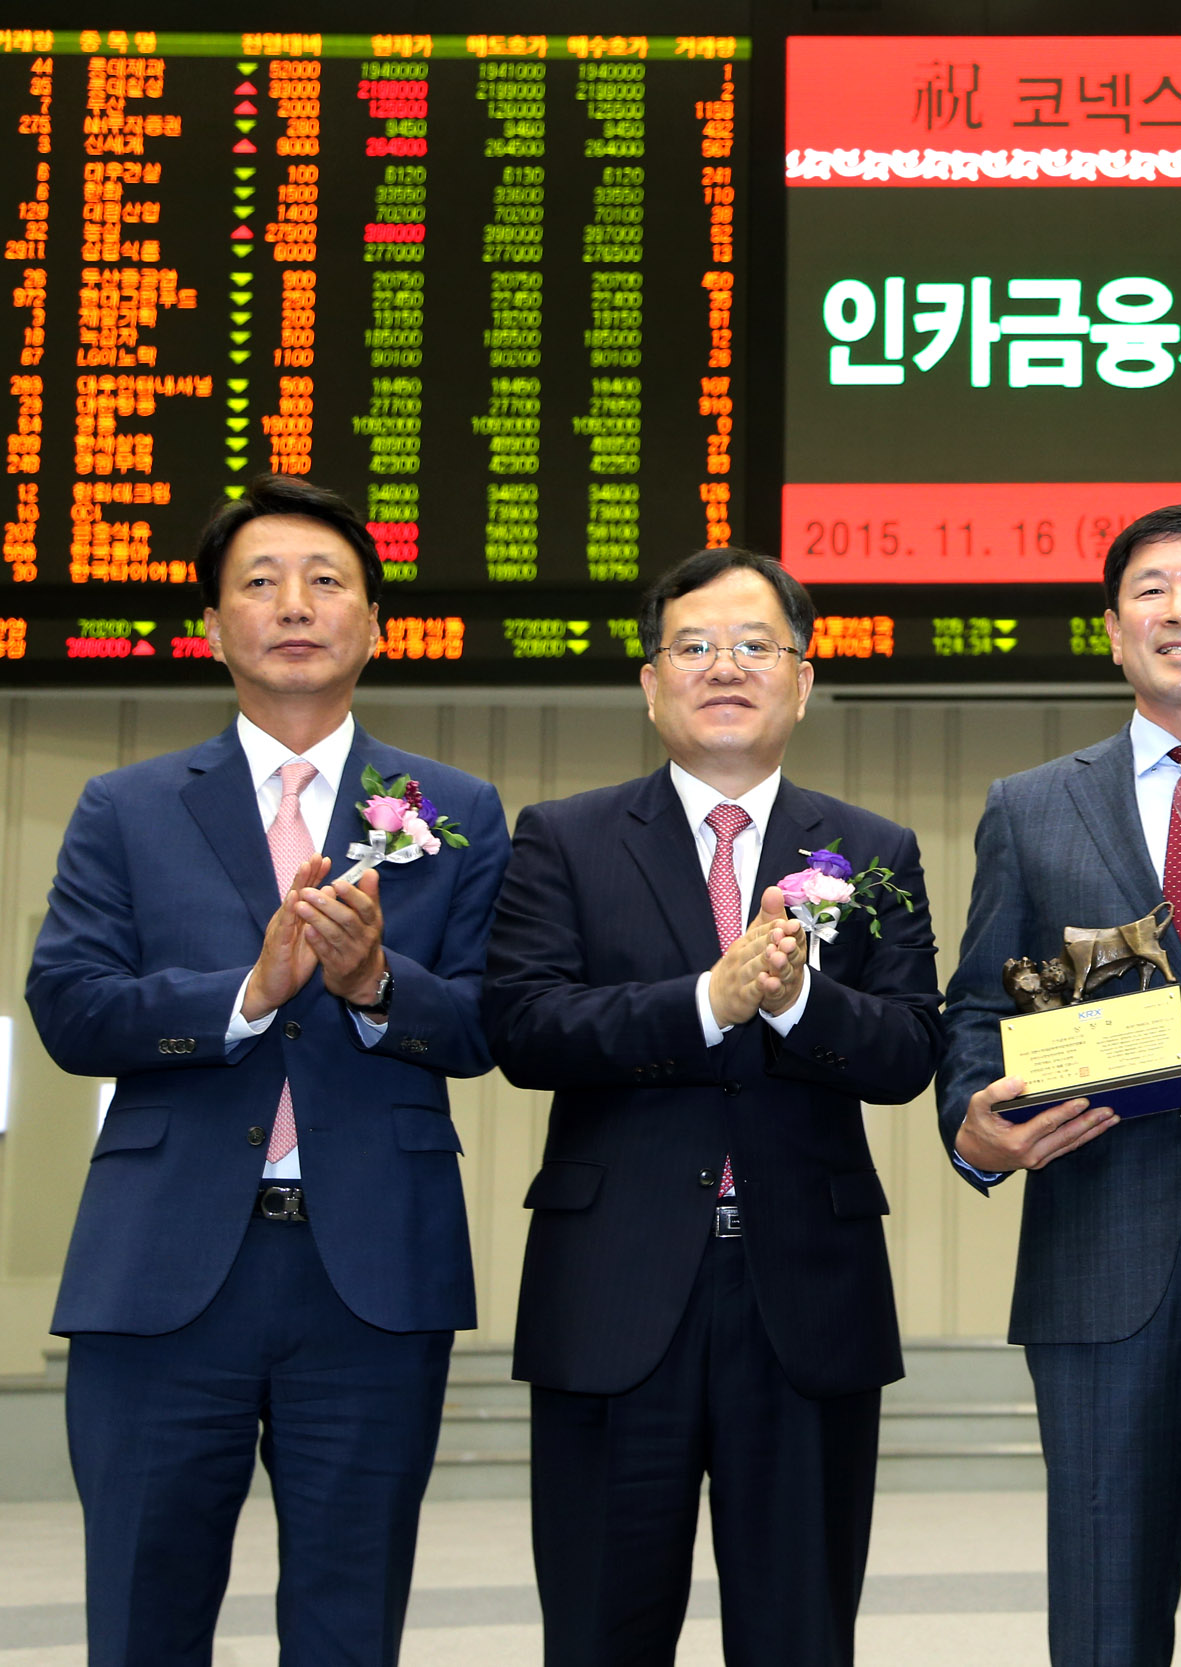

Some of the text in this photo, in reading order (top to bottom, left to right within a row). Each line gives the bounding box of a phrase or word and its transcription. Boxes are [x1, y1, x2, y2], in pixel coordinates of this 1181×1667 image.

[30, 57, 53, 76] 44
[721, 82, 734, 101] 2
[916, 62, 983, 130] 祝
[40, 96, 52, 114] 7
[277, 99, 320, 117] 2000
[288, 164, 319, 182] 100
[274, 348, 314, 367] 1100
[806, 514, 1130, 559] 2015. 11. 16 (월
[1079, 1008, 1101, 1019] KRX
